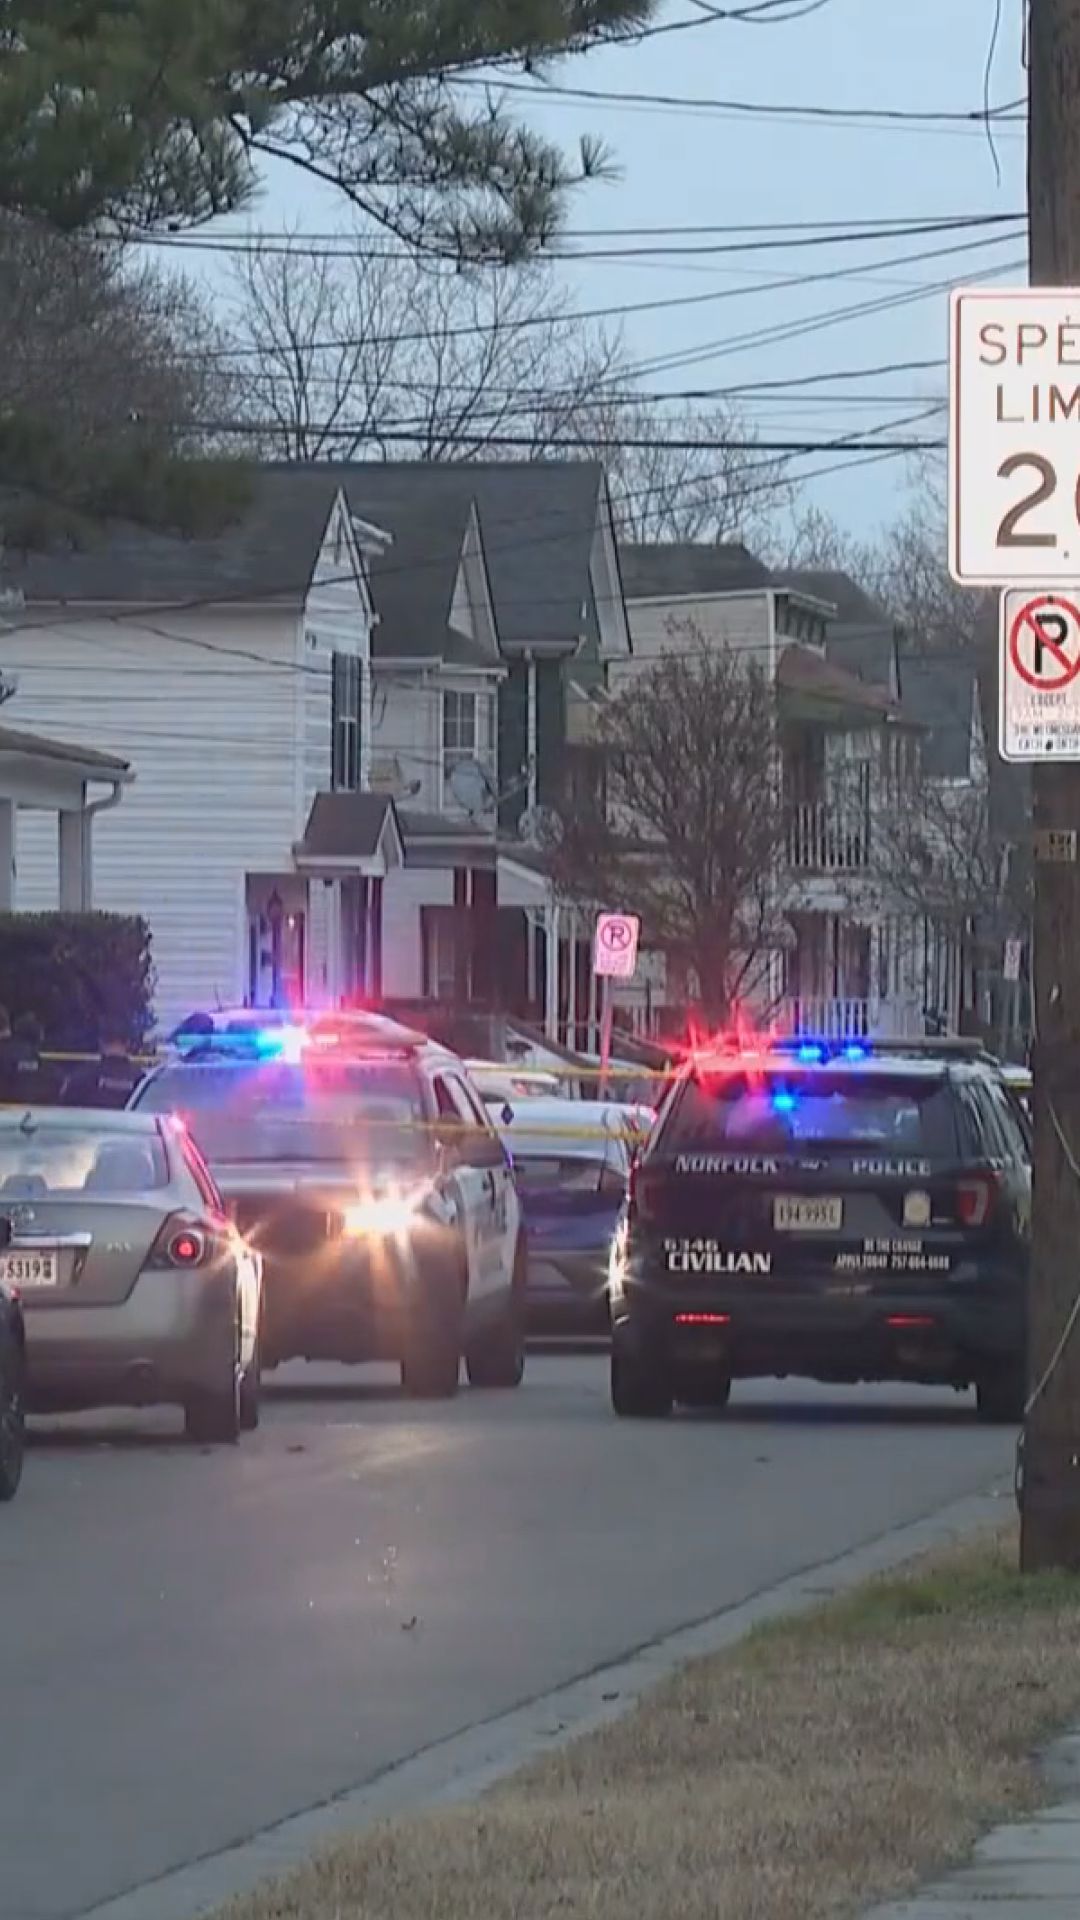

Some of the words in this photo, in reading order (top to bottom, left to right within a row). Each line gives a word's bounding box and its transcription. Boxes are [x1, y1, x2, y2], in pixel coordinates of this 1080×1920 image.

[996, 452, 1080, 548] 2
[676, 1154, 778, 1174] NORFOLK
[852, 1159, 931, 1176] POLICE
[669, 1251, 770, 1272] CIVILIAN
